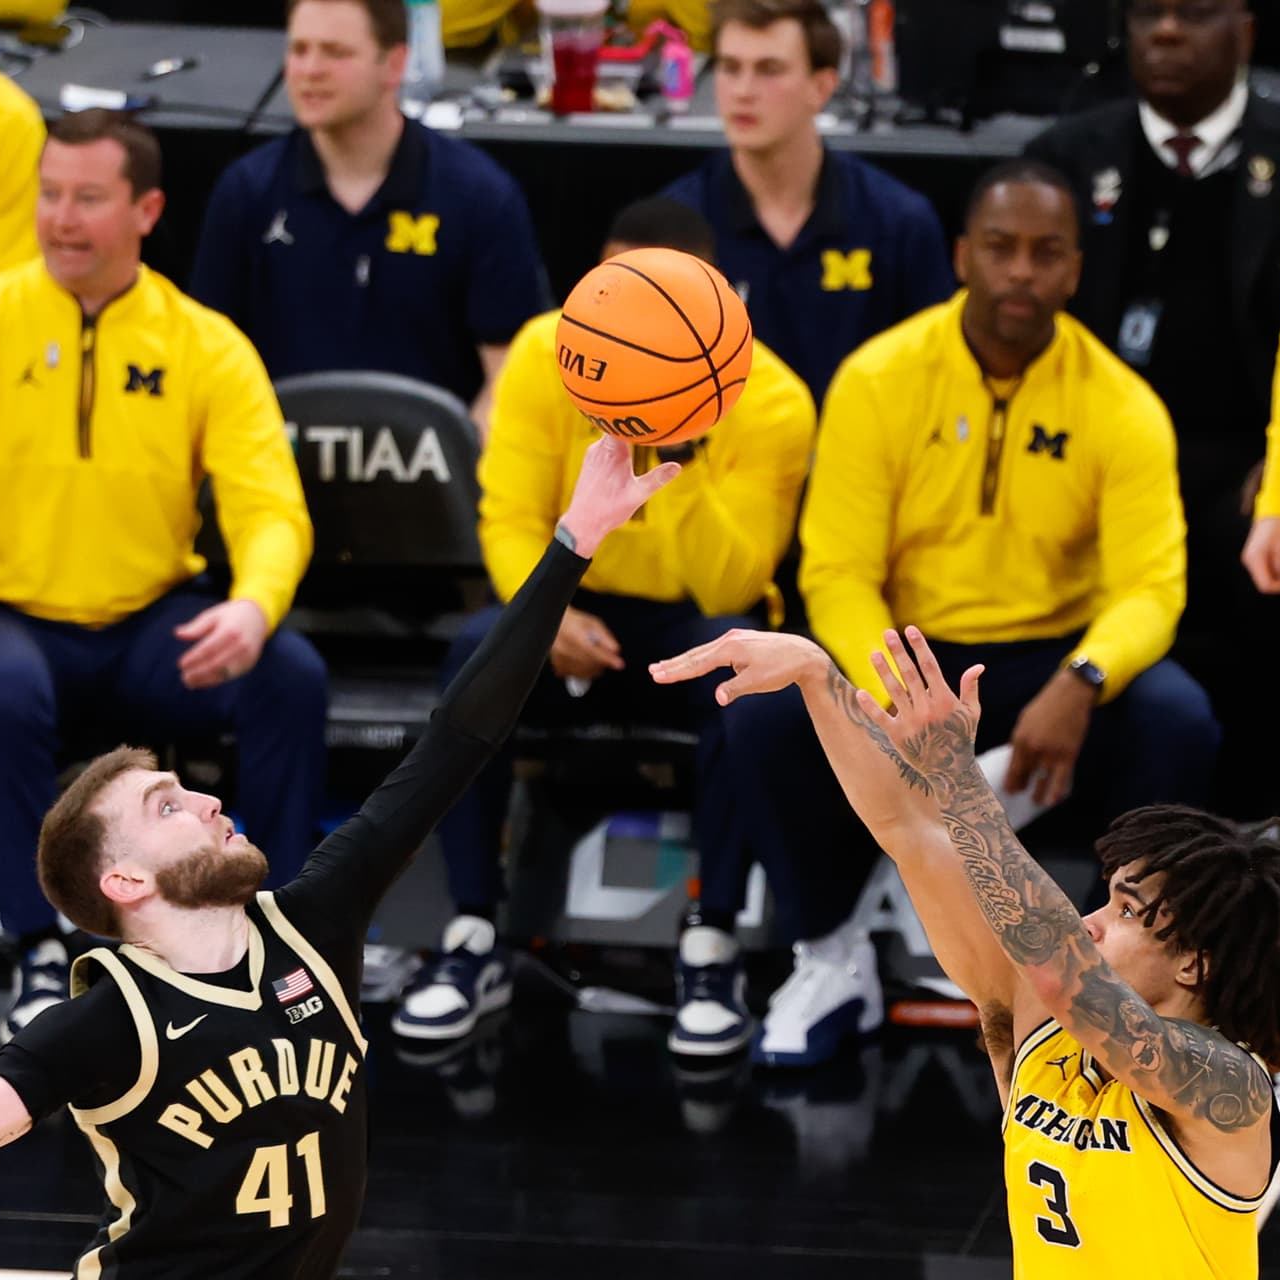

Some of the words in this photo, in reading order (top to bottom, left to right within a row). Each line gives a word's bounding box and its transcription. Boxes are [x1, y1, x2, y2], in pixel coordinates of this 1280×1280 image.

[386, 211, 440, 255] M
[822, 249, 872, 291] M
[125, 364, 164, 396] M
[305, 426, 452, 482] TIAA
[1027, 424, 1070, 461] M
[285, 996, 324, 1025] BIG
[157, 1037, 358, 1150] PURDUE
[1014, 1094, 1132, 1152] MIHGAN
[235, 1131, 326, 1229] 41
[1027, 1160, 1081, 1249] 3
